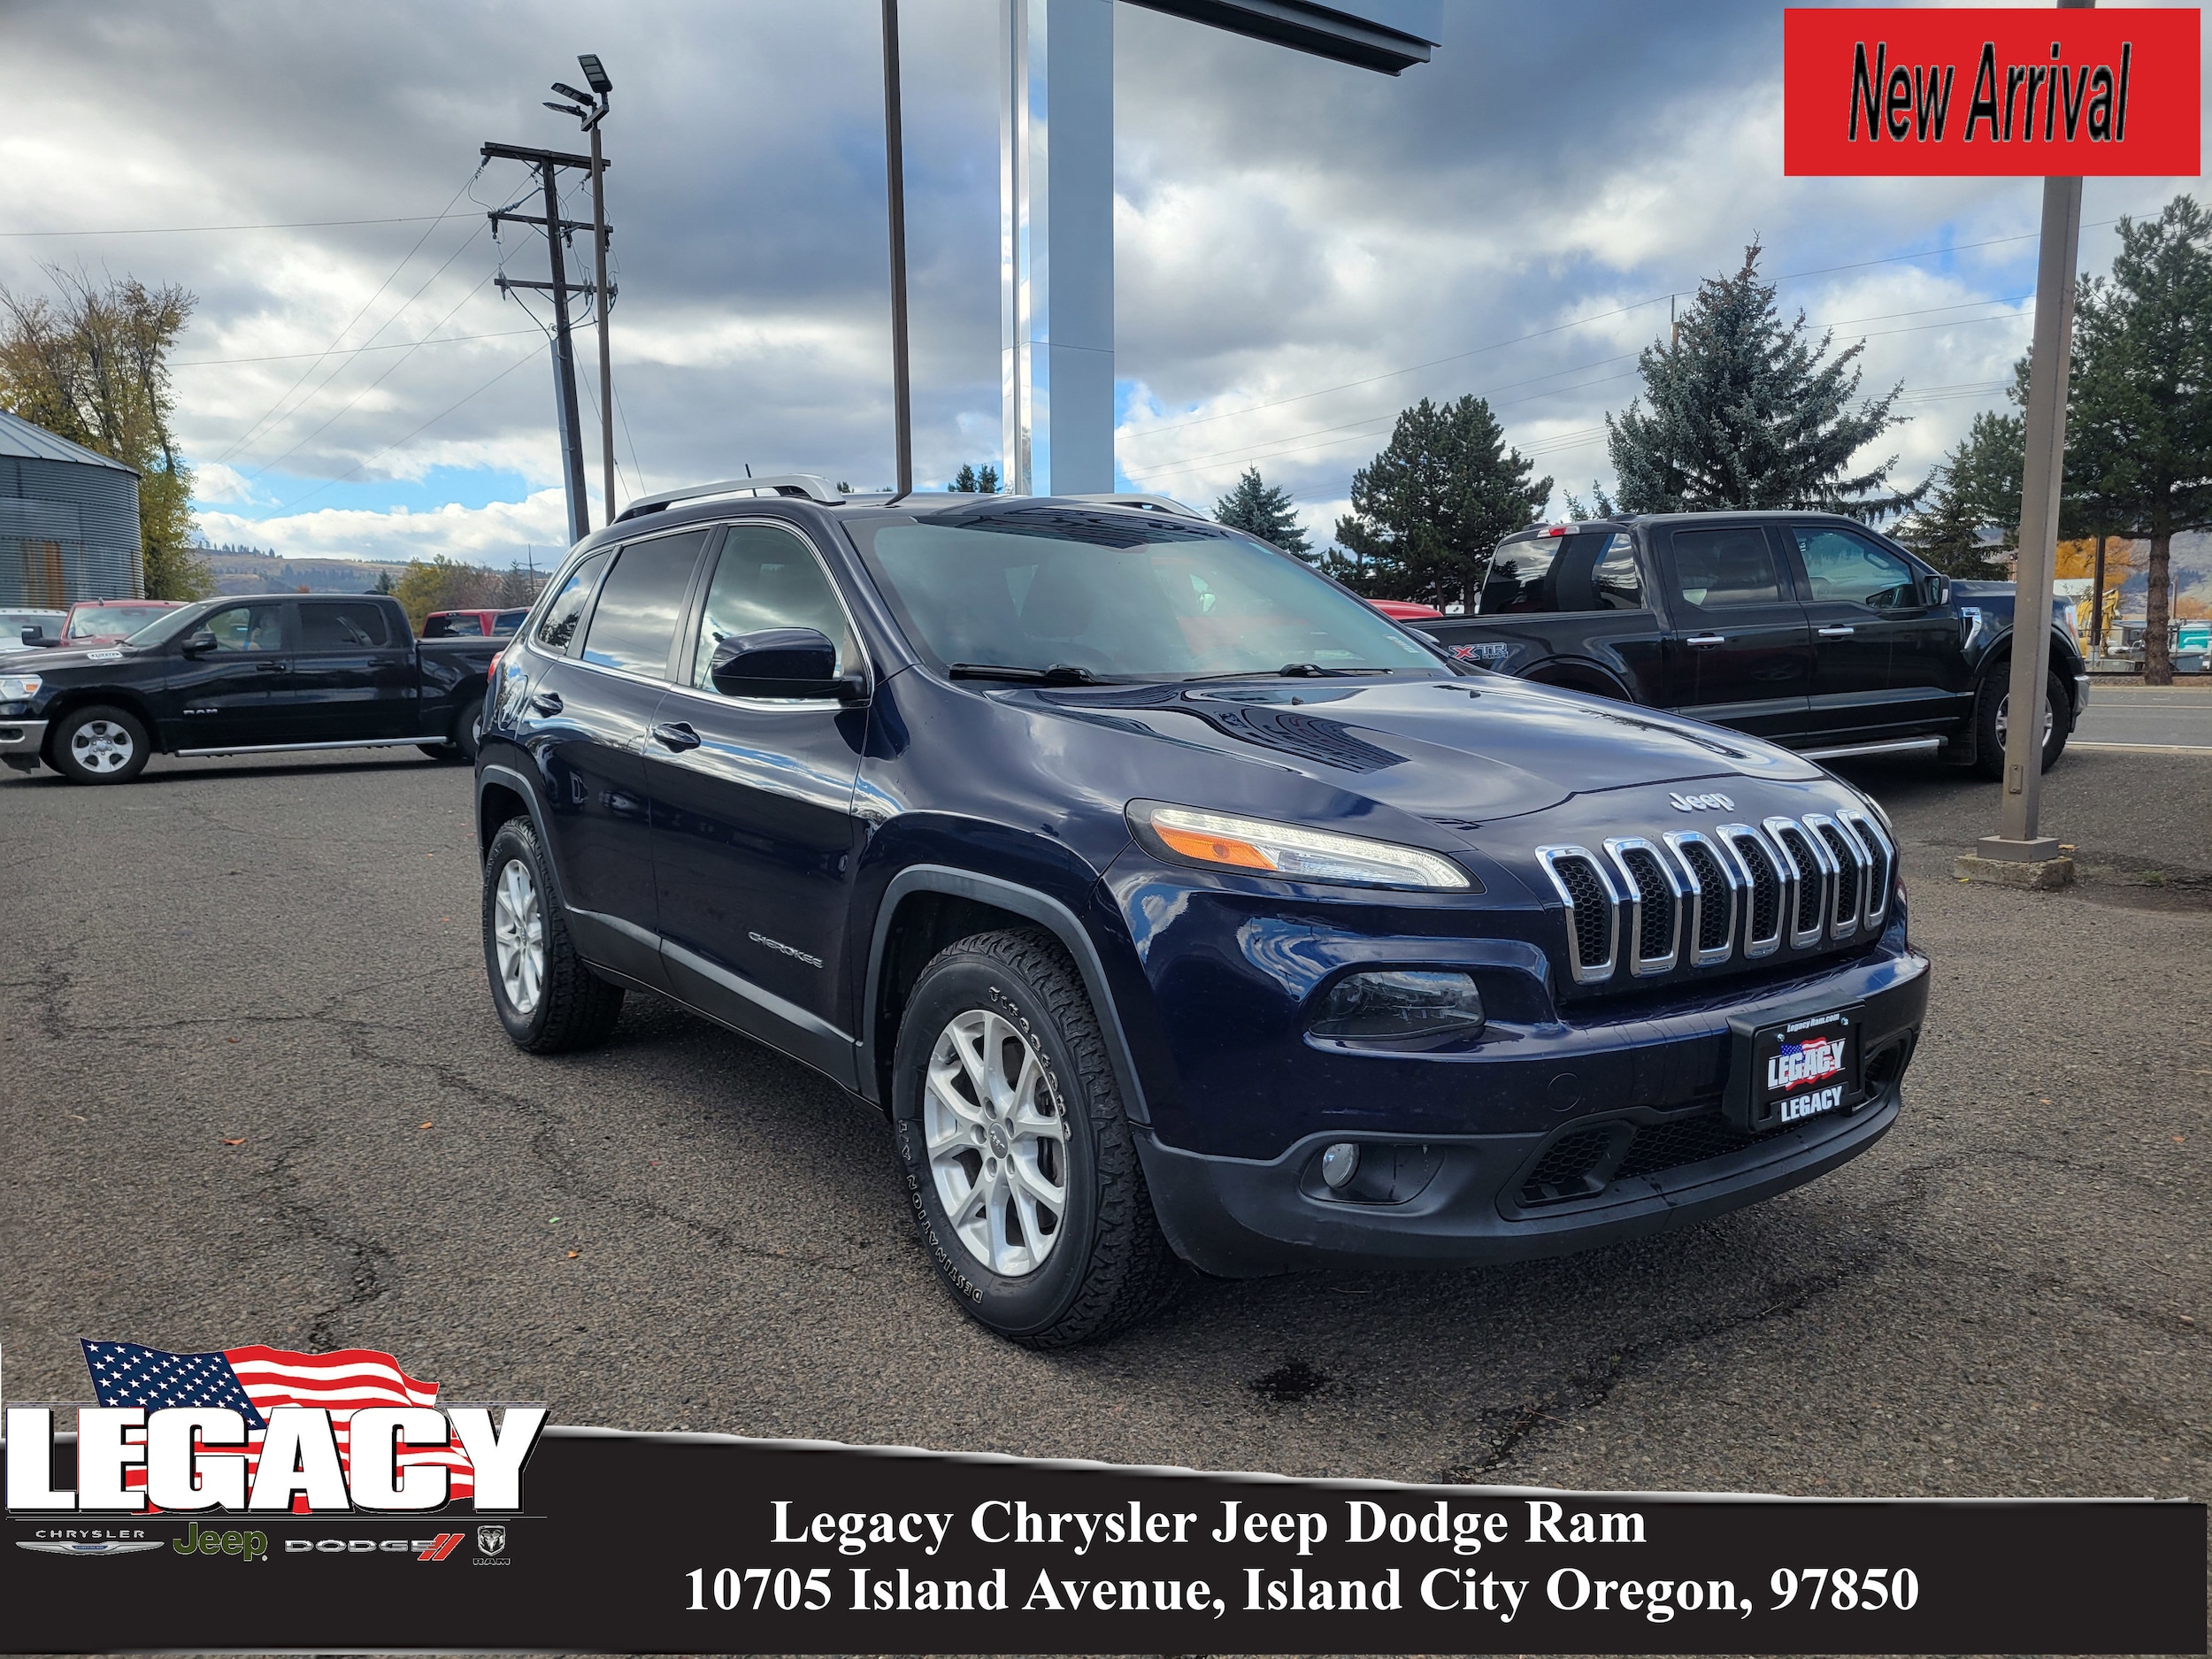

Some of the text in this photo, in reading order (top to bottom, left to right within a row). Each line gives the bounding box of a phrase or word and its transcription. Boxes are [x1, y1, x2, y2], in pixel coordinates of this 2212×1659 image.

[1669, 792, 1735, 812] Jeep
[1767, 1040, 1847, 1088] LEGACY
[1780, 1086, 1843, 1123] LEGACY
[906, 1173, 985, 1304] DESTINATION
